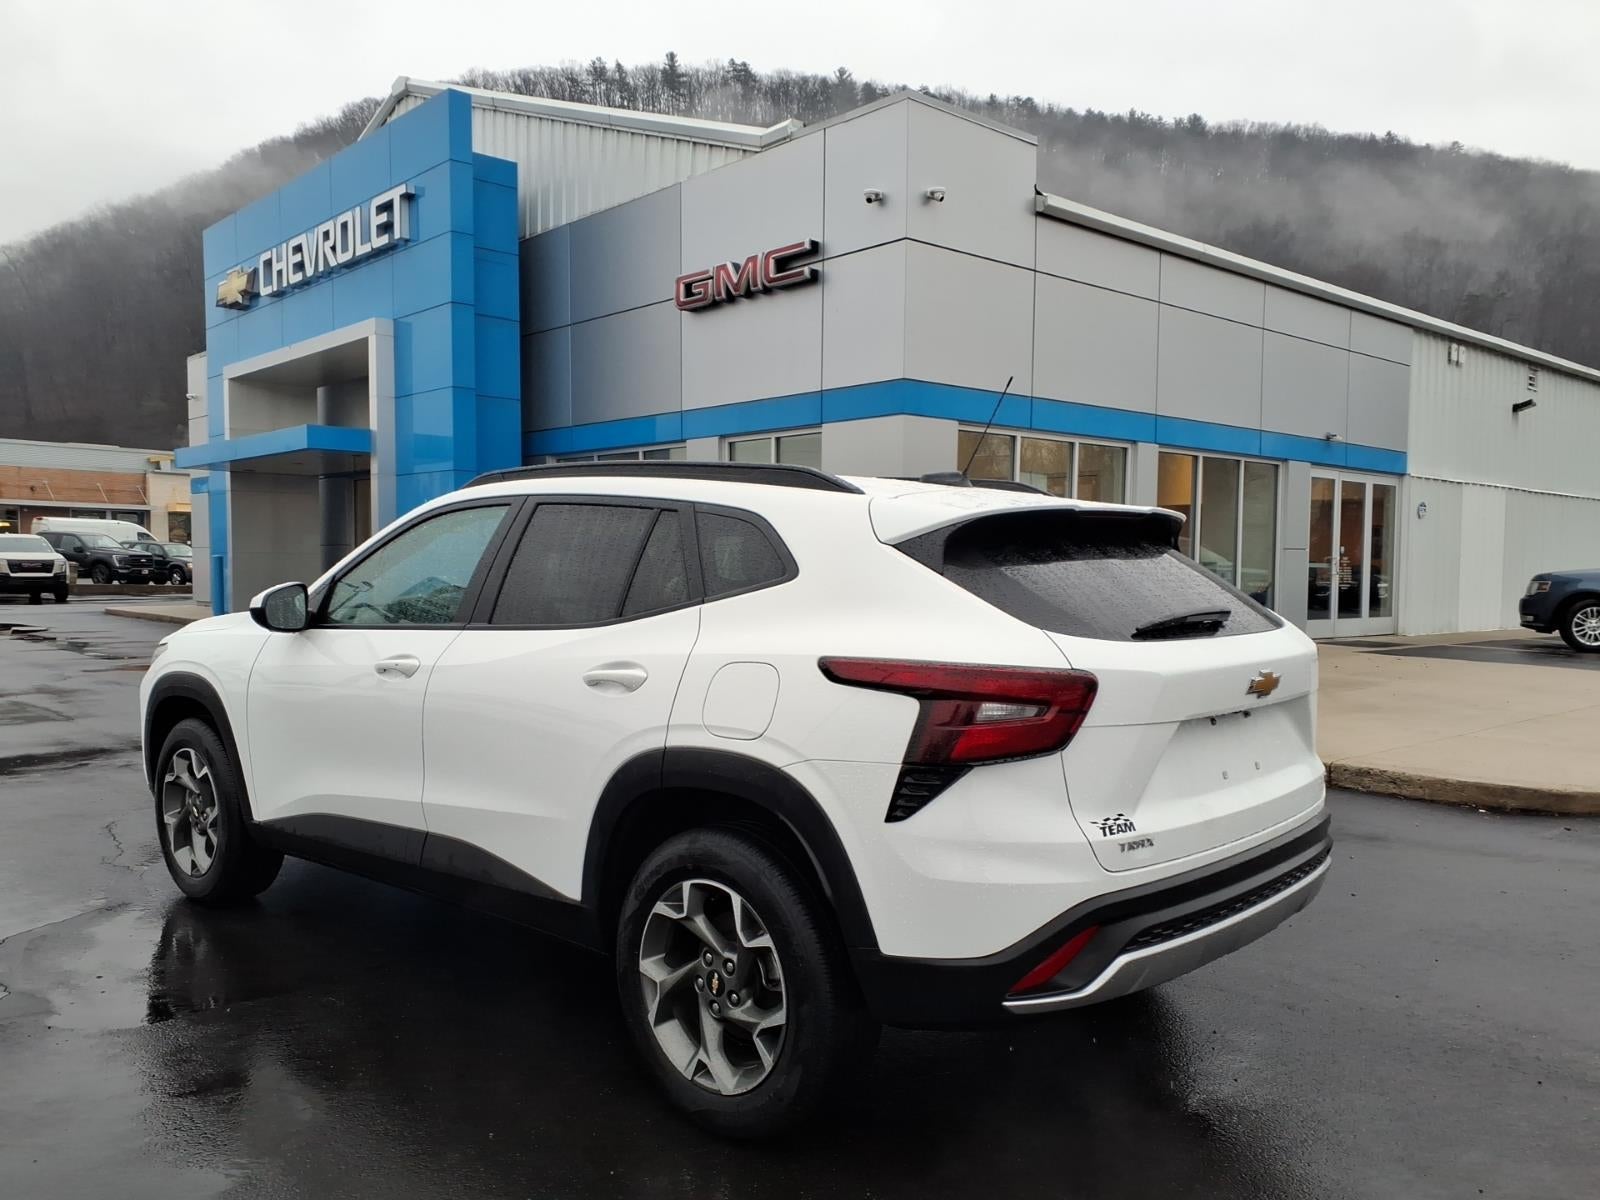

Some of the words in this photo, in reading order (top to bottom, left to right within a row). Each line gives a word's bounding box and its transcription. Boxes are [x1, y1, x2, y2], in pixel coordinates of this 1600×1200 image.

[258, 183, 414, 297] CHEVROLET
[674, 238, 814, 312] GMC
[1099, 821, 1136, 837] TEAM
